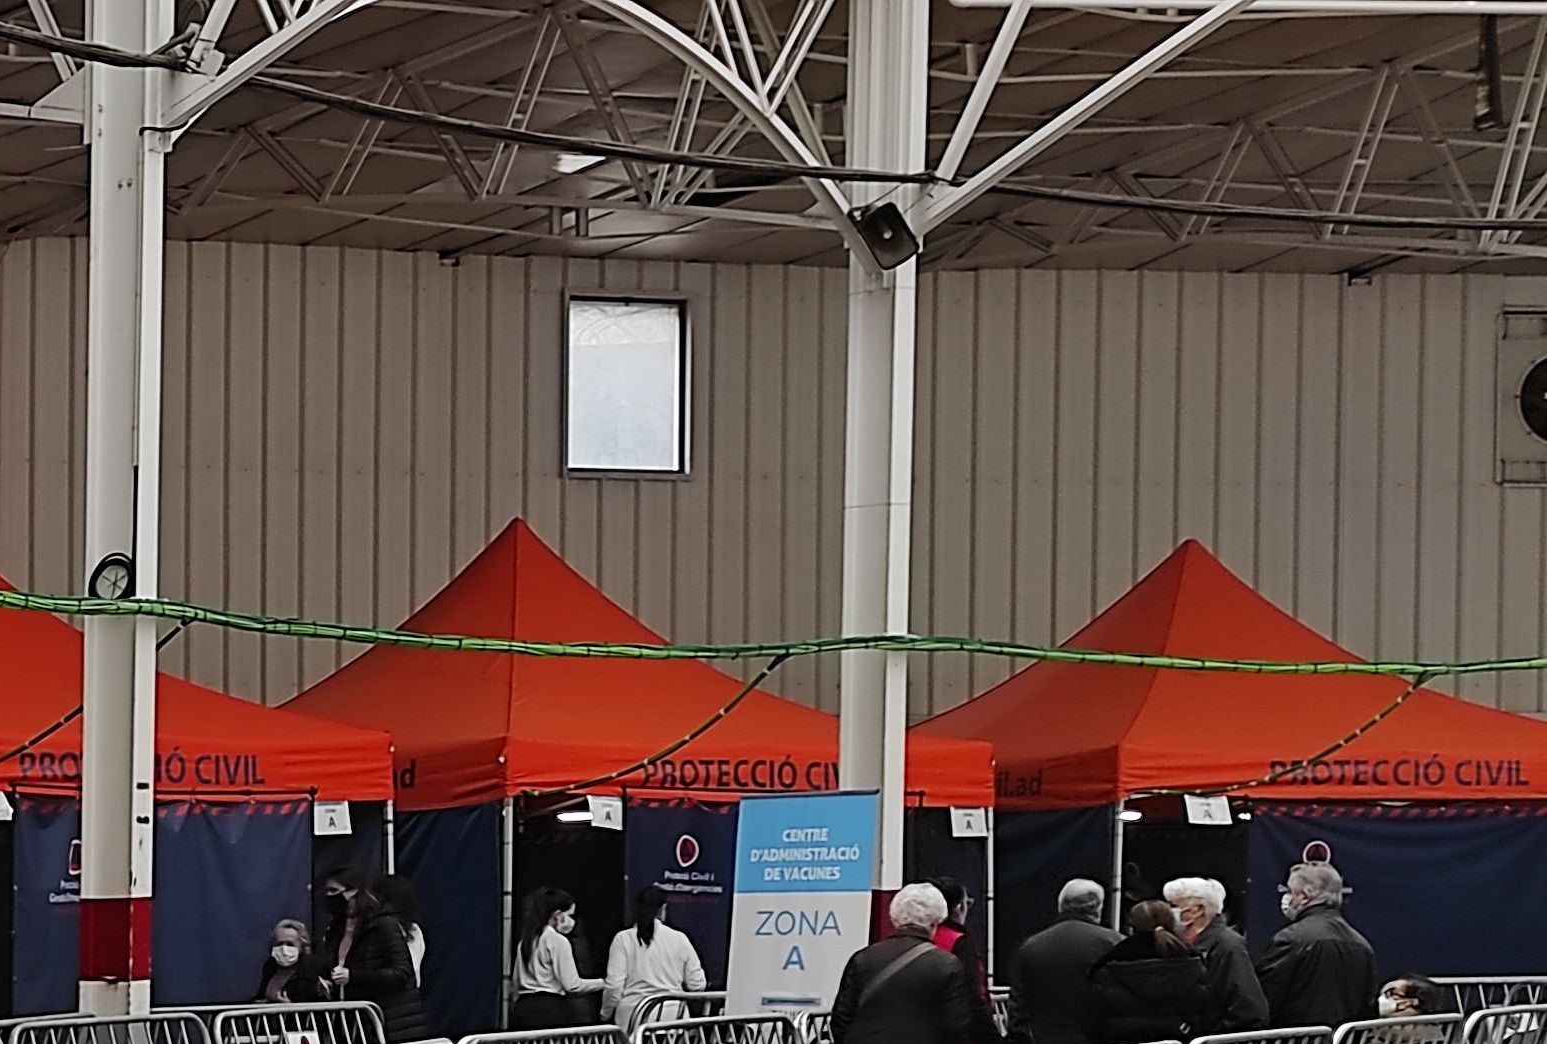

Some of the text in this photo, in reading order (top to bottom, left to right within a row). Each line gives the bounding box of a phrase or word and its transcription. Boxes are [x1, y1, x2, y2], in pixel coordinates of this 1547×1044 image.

[195, 753, 265, 785] CIVIL
[642, 755, 797, 788] PROTECCIÓ
[1270, 754, 1530, 786] PROTECCIÓ CIVIL
[328, 816, 337, 828] A
[781, 828, 829, 843] CENTRE
[750, 844, 860, 863] D'ADMINISTRACIÓ
[764, 866, 841, 881] DE VACUNES
[755, 911, 841, 936] ZONA
[782, 946, 805, 970] A
